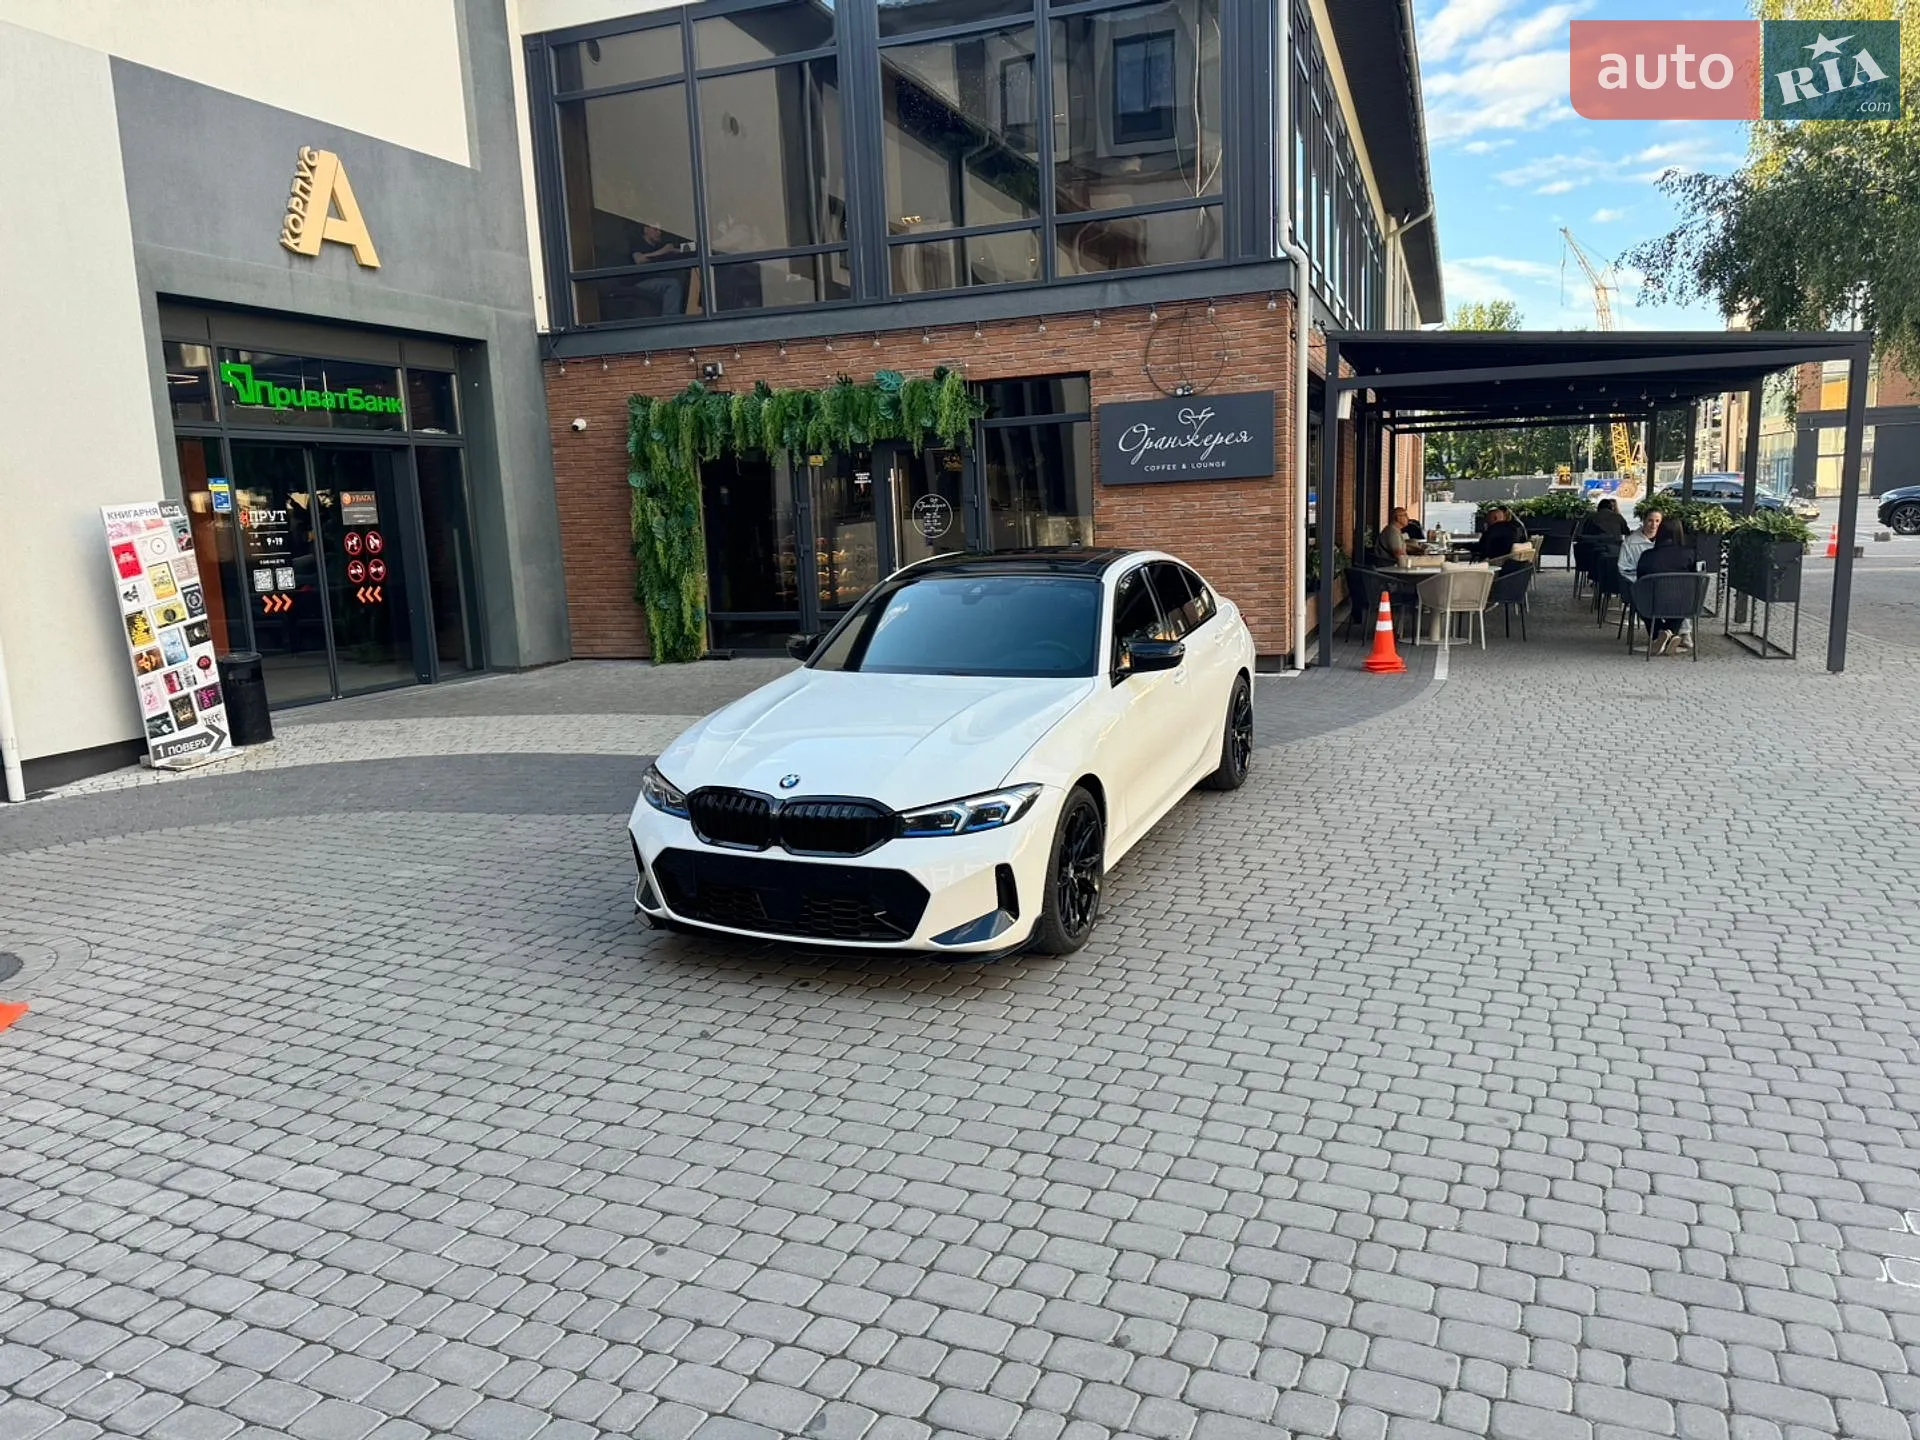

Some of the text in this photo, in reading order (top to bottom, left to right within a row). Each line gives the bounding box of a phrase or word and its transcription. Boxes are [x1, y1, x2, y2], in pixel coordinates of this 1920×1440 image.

[280, 145, 320, 252] КОРПУС
[255, 379, 403, 415] ПриватБанк
[1118, 407, 1254, 466] Оранжерея
[1144, 463, 1177, 472] COFFEE
[1191, 461, 1227, 469] LOUNGE
[106, 507, 159, 520] КНИГАРНЯ
[156, 737, 208, 757] 1 ПОВЕРХ
